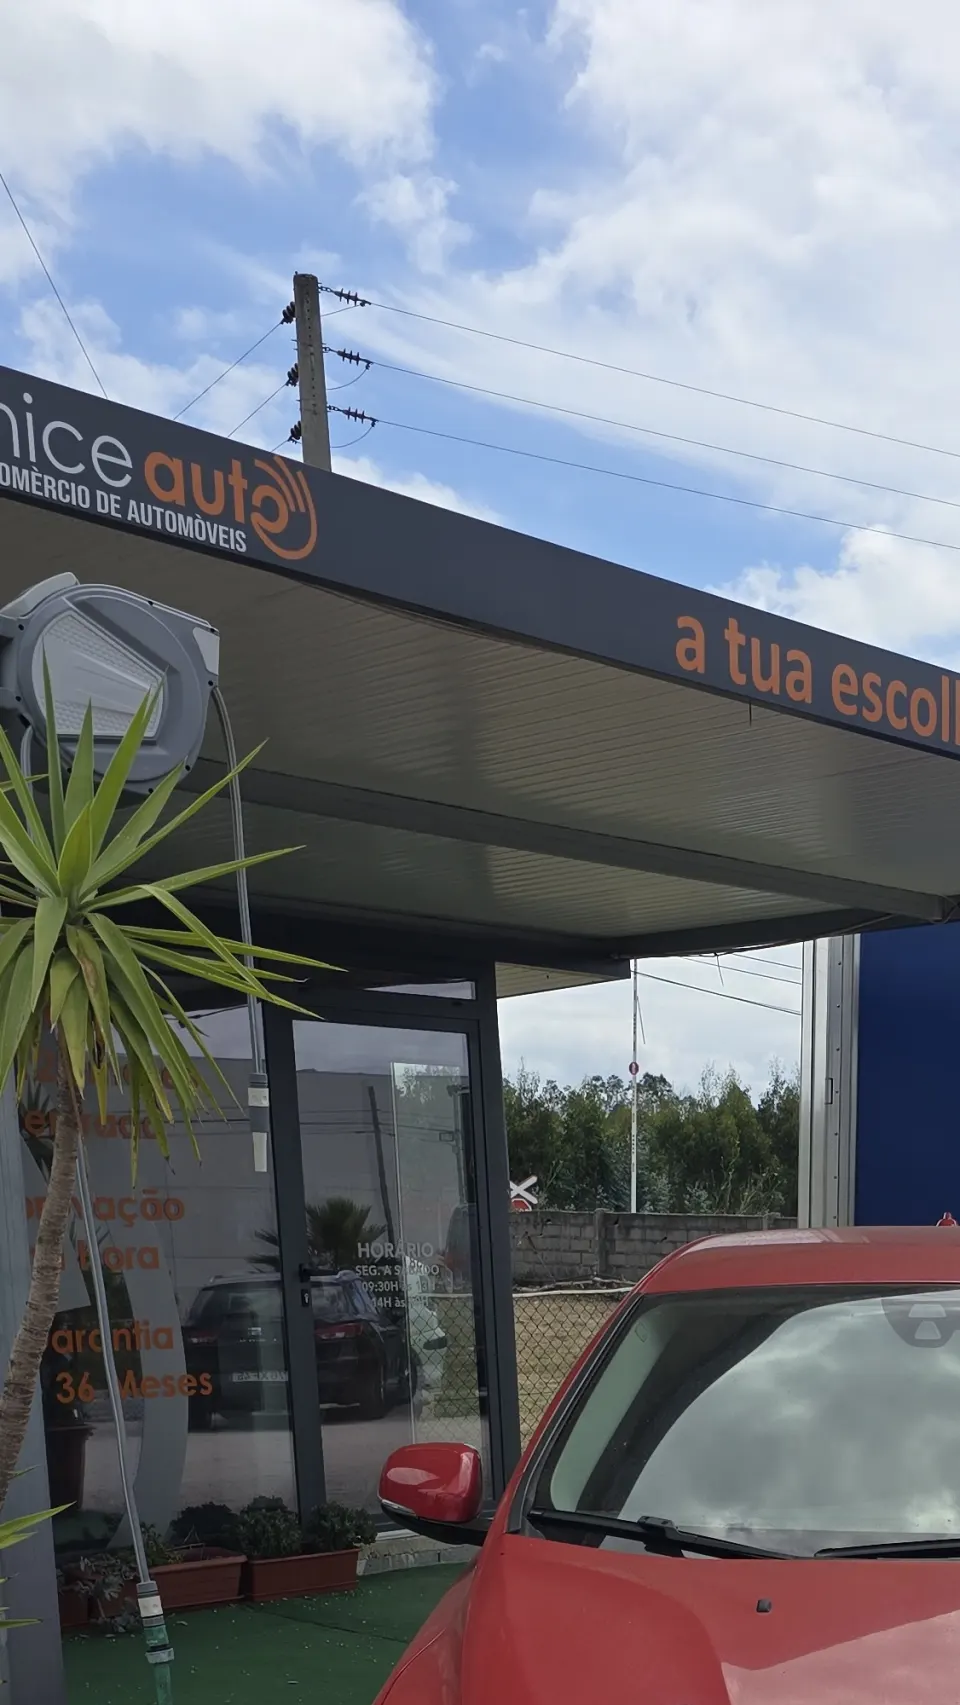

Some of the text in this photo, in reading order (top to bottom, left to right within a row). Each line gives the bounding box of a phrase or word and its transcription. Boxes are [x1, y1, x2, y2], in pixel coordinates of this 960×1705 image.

[0, 462, 90, 509] OMÈRCIO
[96, 489, 121, 519] DE
[674, 615, 705, 674] a
[724, 617, 812, 703] tua
[355, 1264, 381, 1277] SEG.
[55, 1371, 96, 1404] 36
